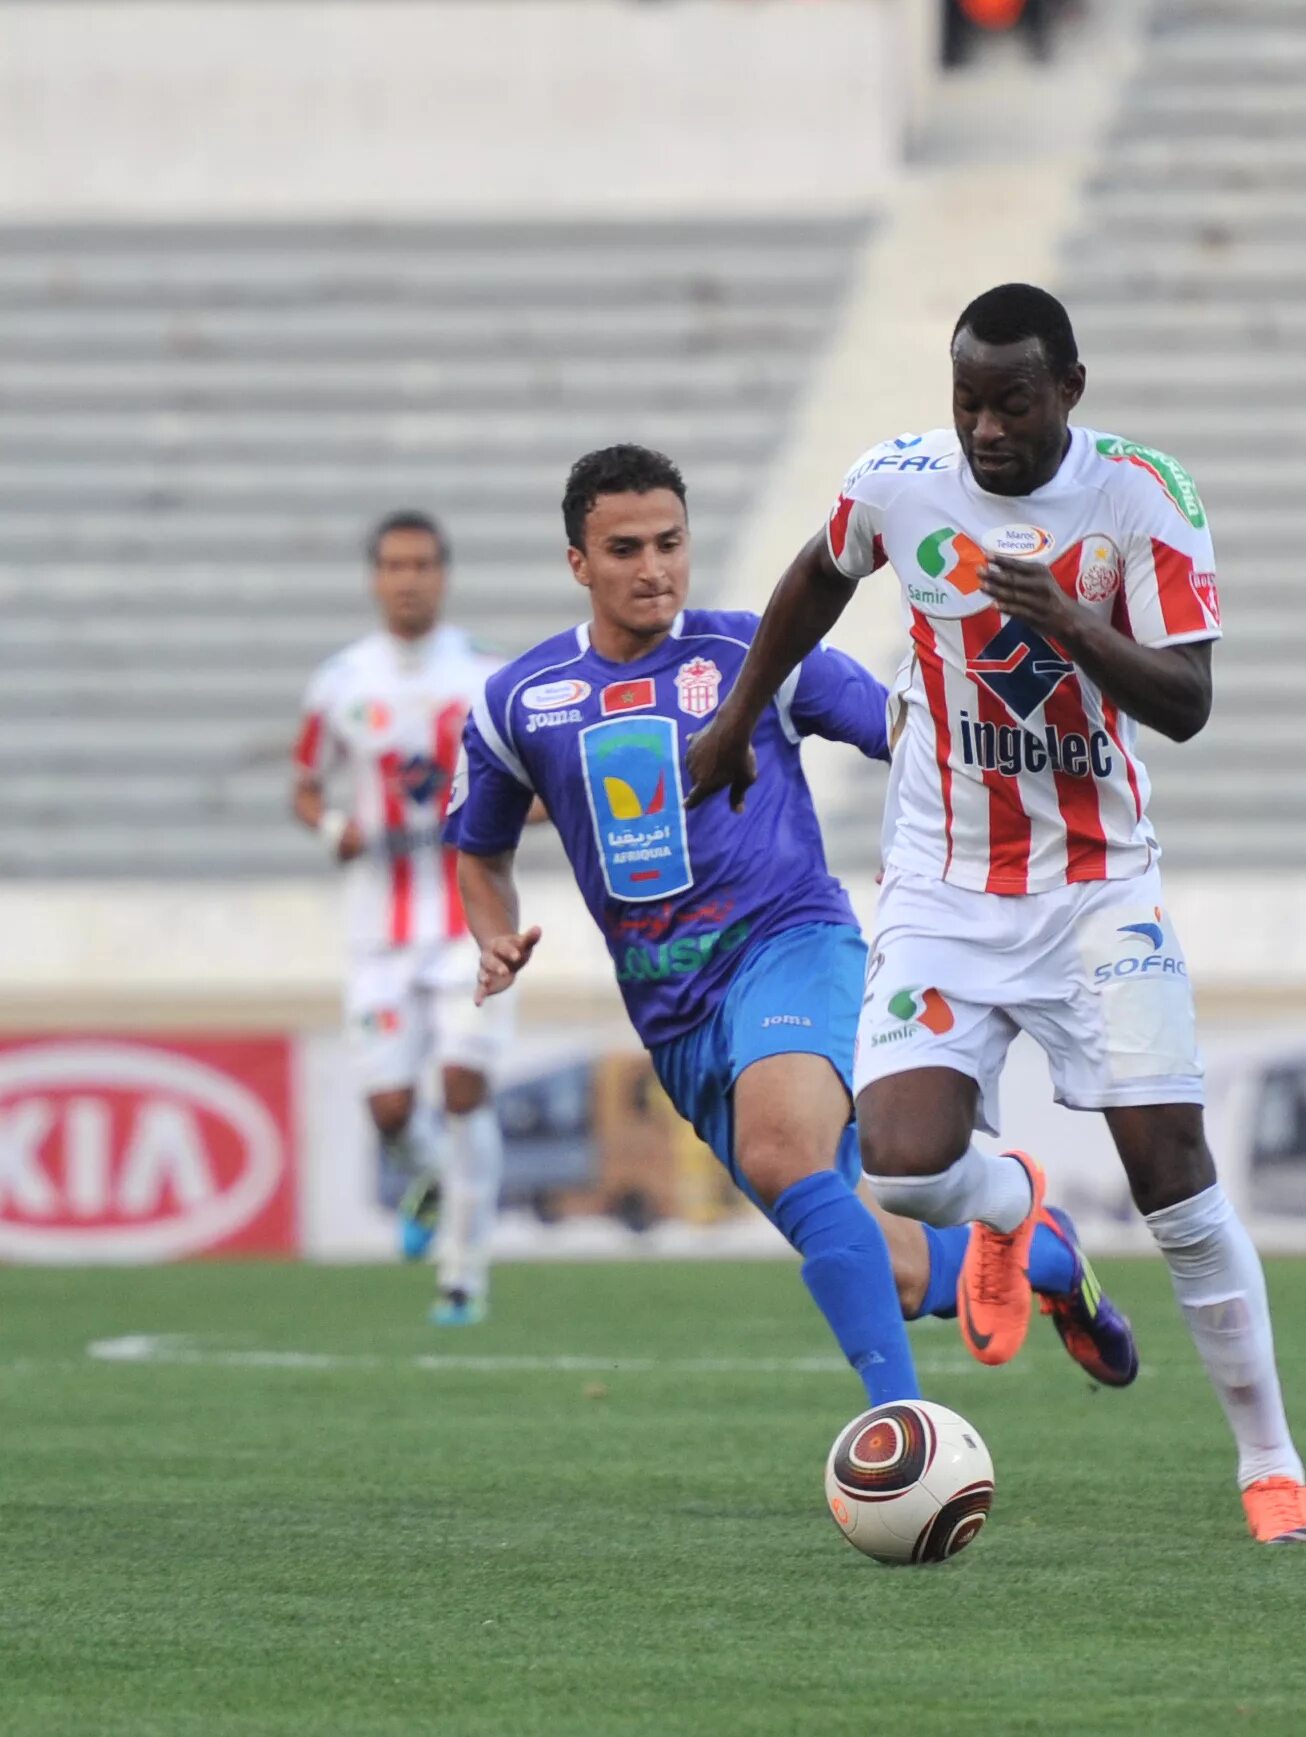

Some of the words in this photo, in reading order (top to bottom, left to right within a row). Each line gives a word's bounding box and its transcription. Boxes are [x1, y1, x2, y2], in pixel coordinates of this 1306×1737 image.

[996, 539, 1036, 550] Telecom
[1005, 530, 1036, 541] Maroc
[907, 583, 949, 606] Samir
[960, 710, 1113, 778] ingelec
[1093, 954, 1190, 985] SOFAC
[0, 1097, 208, 1214] KIA
